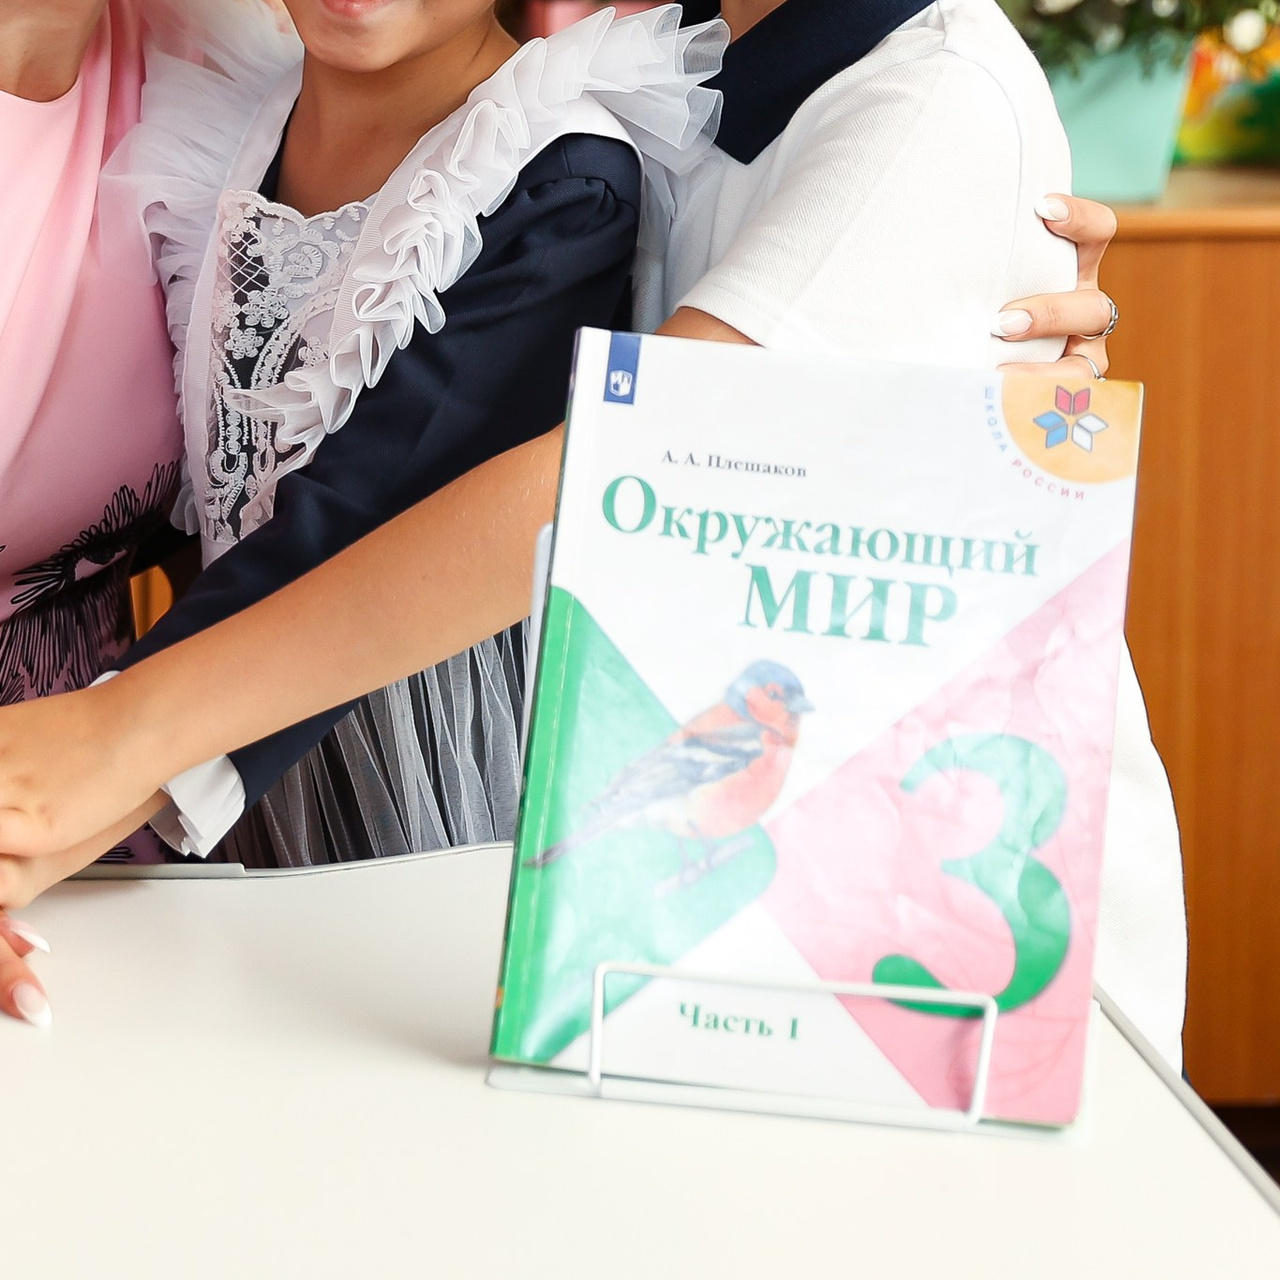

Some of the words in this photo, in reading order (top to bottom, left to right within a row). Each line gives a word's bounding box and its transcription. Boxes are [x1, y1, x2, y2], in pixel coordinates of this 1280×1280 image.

[707, 454, 807, 478] Плешаков
[602, 475, 1042, 577] Окружающий
[738, 563, 960, 648] МИР
[871, 733, 1073, 1019] 3
[678, 1000, 775, 1038] Часть
